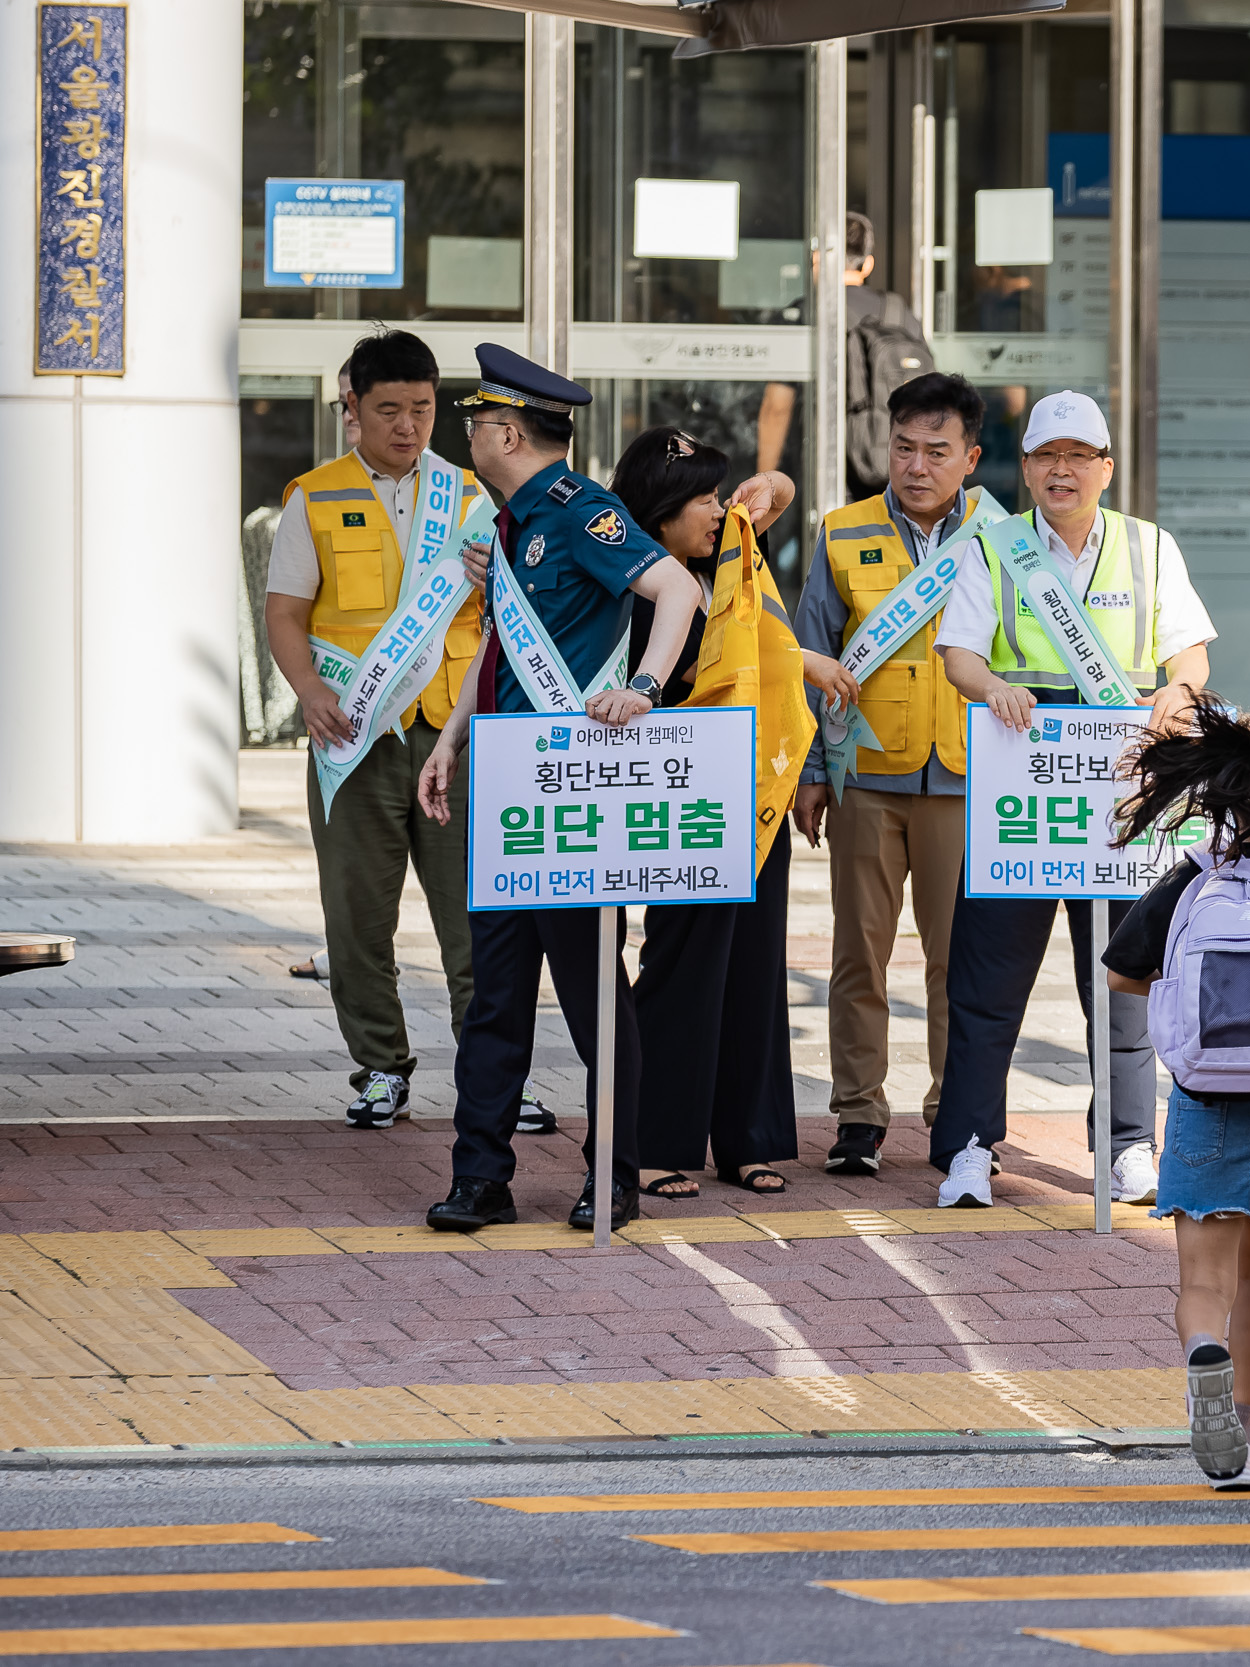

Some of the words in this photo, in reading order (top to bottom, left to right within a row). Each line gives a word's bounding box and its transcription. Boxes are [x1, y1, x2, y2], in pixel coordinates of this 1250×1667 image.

[54, 15, 112, 360] 서울광진경찰서
[428, 470, 452, 514] 아이
[418, 519, 446, 565] 먼저
[609, 529, 623, 541] POLICE
[417, 575, 454, 619] 아이
[915, 558, 960, 604] 아이
[380, 614, 424, 664] 먼저
[501, 601, 537, 654] 먼저
[867, 598, 917, 647] 먼저
[1041, 588, 1094, 662] 횡단보도
[1086, 661, 1106, 683] 앞
[576, 726, 641, 747] 아이먼저
[645, 725, 694, 744] 캠페인
[1067, 721, 1127, 740] 아이먼저
[534, 760, 654, 793] 횡단보도
[663, 757, 694, 789] 앞
[500, 803, 604, 855] 일단
[625, 798, 727, 851] 멈춤
[995, 795, 1093, 844] 일단
[494, 870, 540, 897] 아이
[549, 868, 594, 896] 먼저
[602, 865, 728, 893] 보내주세요.
[990, 860, 1033, 886] 아이
[1041, 860, 1085, 886] 먼저
